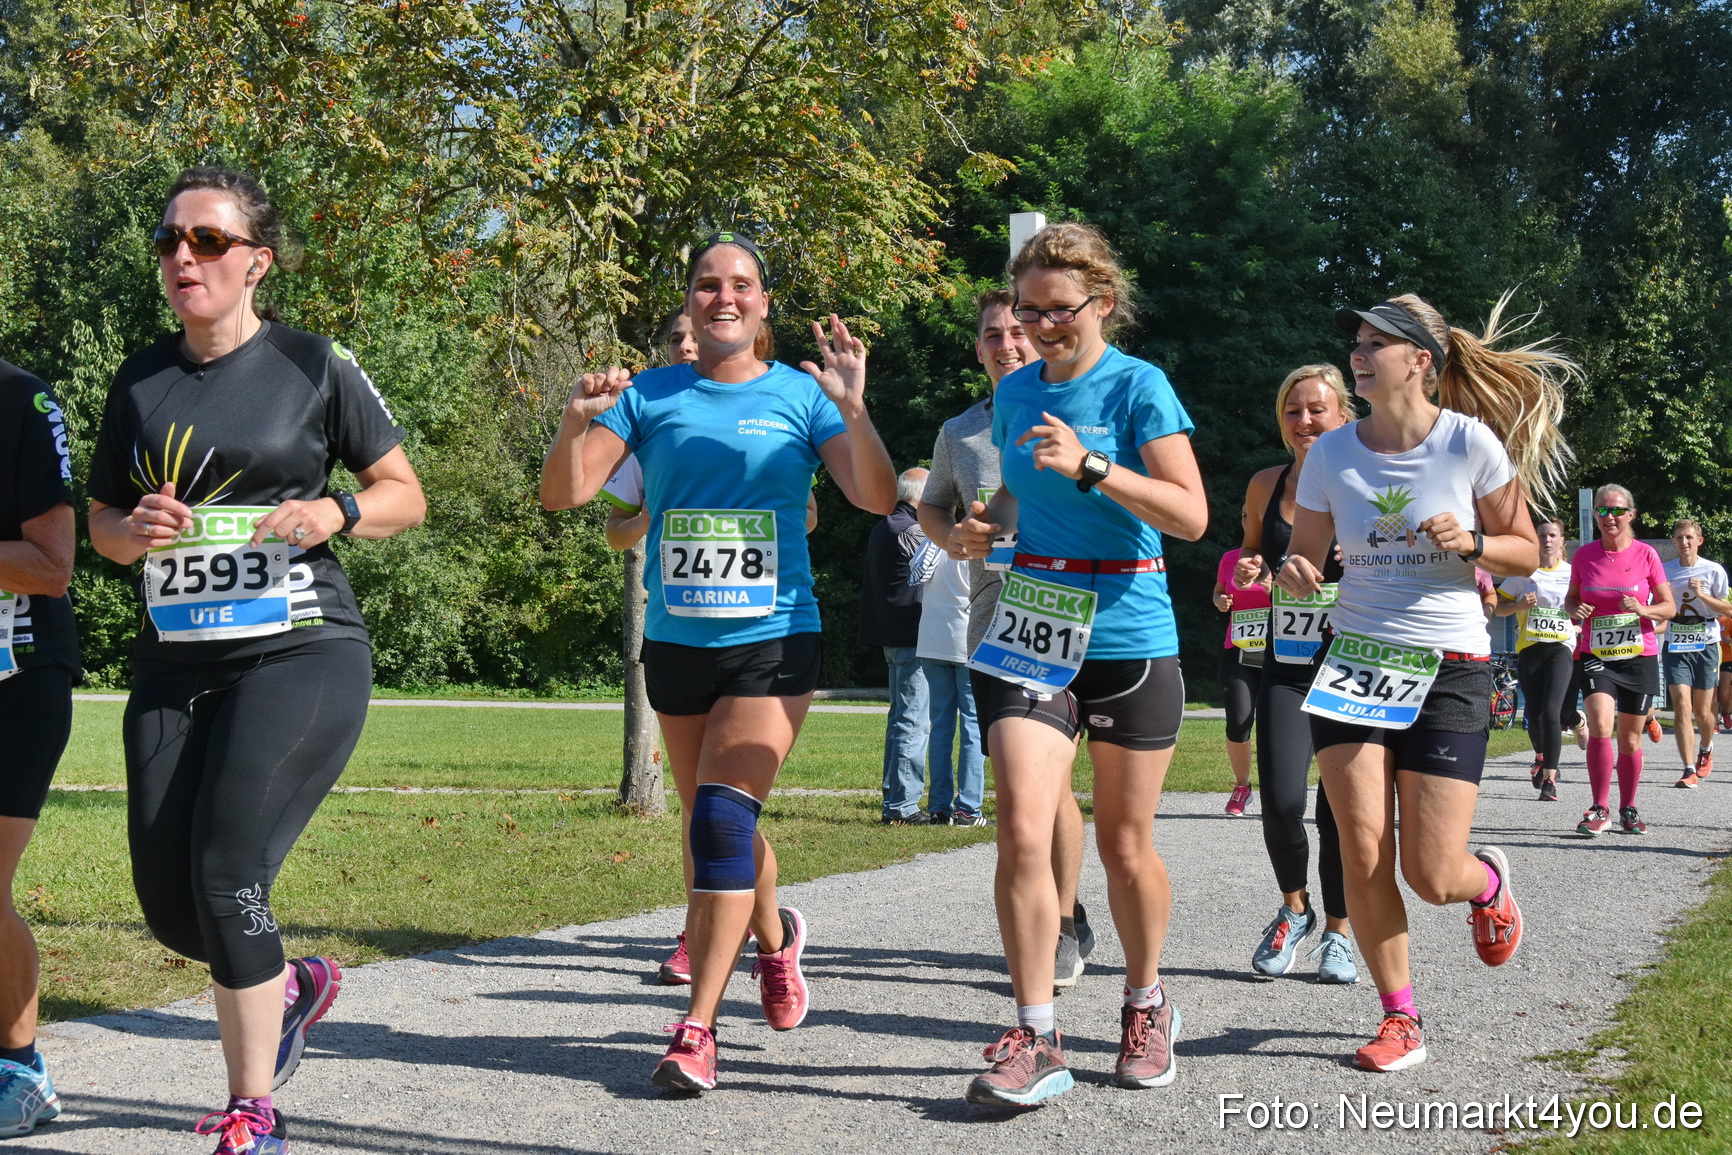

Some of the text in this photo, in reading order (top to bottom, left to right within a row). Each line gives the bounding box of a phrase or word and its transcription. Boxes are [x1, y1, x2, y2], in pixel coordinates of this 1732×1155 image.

[738, 427, 767, 435] Carina
[747, 419, 789, 430] PFLEIDERER
[670, 514, 765, 537] BOCK
[671, 547, 764, 579] 2478
[1349, 550, 1450, 566] GESUND UND FIT
[159, 551, 269, 597] 2593
[1373, 567, 1417, 577] mit Julia
[682, 590, 750, 604] CARINA
[1006, 578, 1086, 618] BOCK
[190, 606, 233, 625] UTE
[1533, 607, 1569, 619] BOCK
[1533, 619, 1565, 632] 1045
[1594, 615, 1638, 628] BOCK
[1672, 624, 1703, 632] BOCK
[998, 611, 1071, 661] 2481
[1596, 630, 1637, 646] 1274
[1673, 634, 1702, 644] 2294
[1339, 635, 1428, 672] BOCK
[1600, 648, 1633, 656] MARION
[1000, 655, 1050, 680] IRENE
[1328, 664, 1420, 702] 2347
[1337, 702, 1386, 719] JULIA
